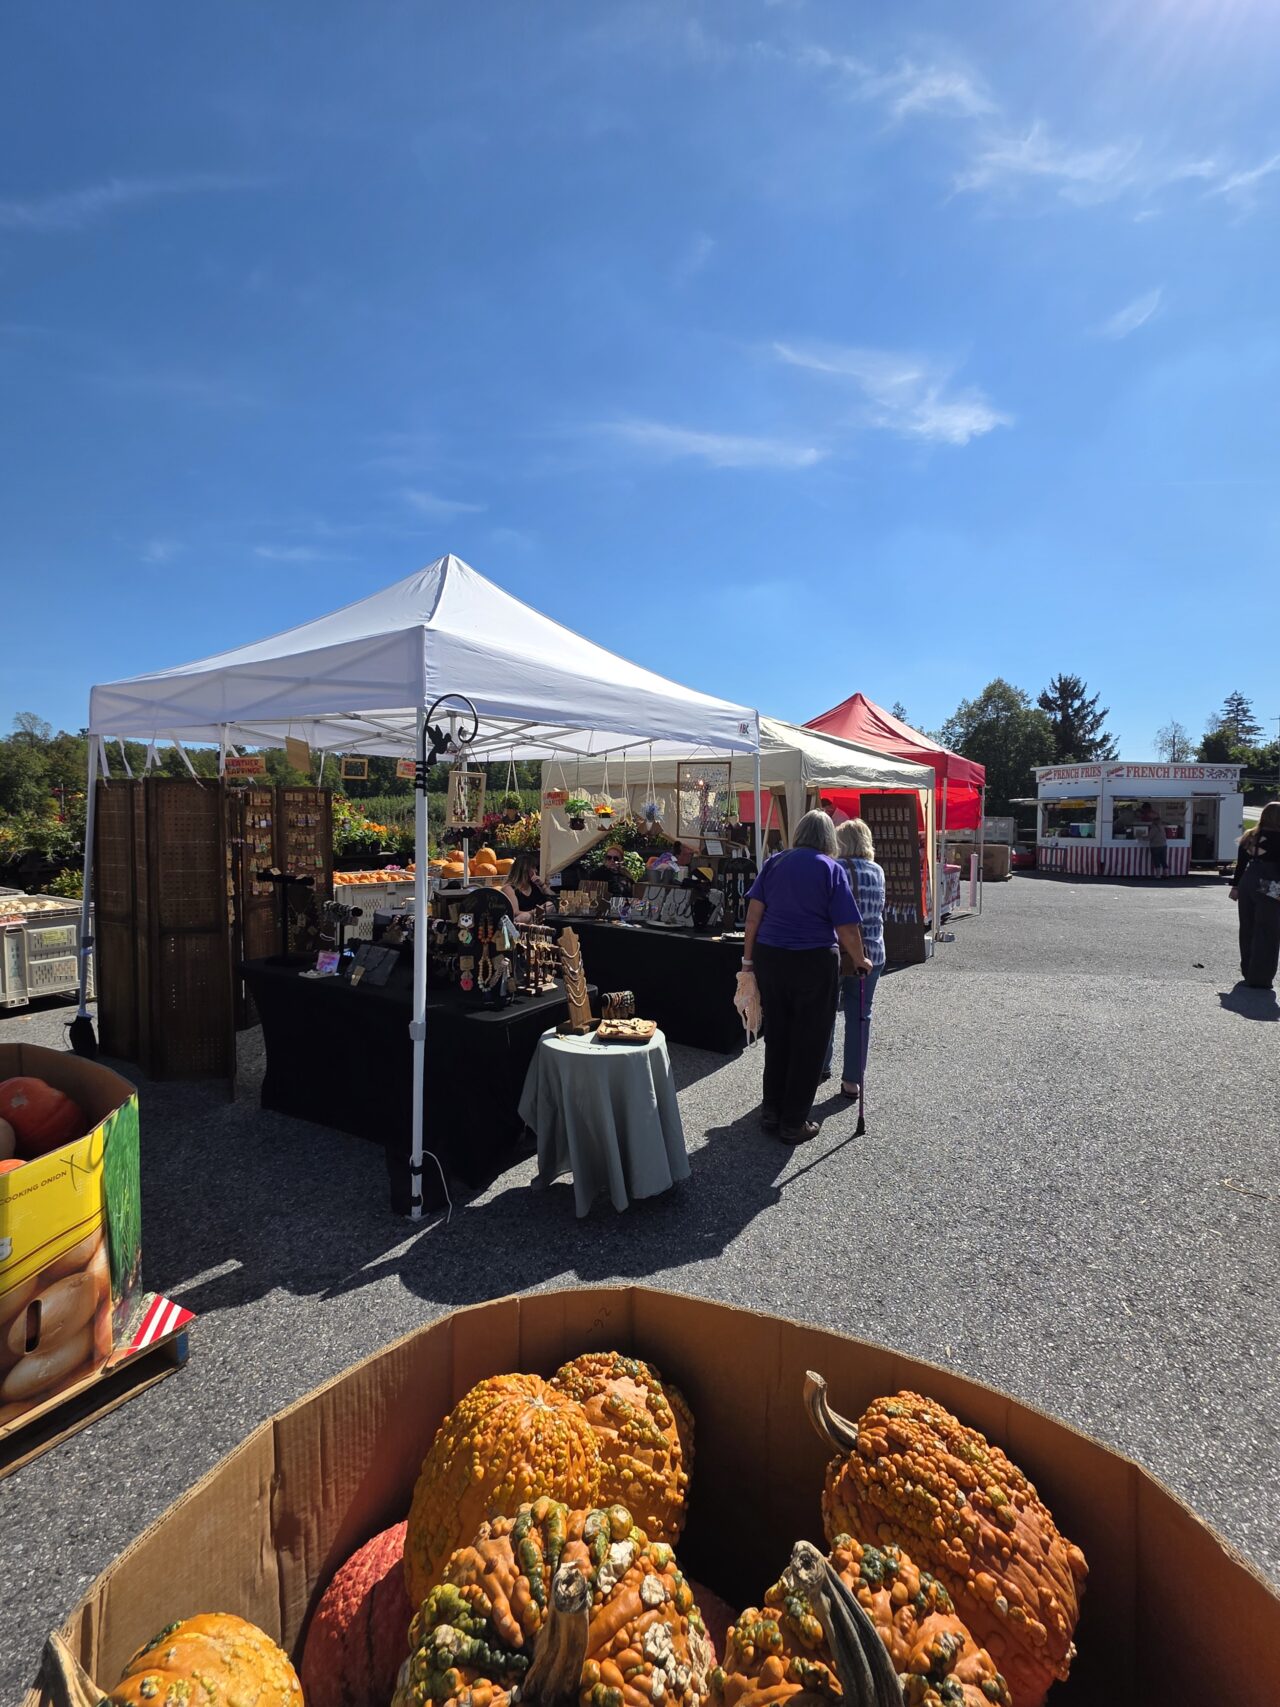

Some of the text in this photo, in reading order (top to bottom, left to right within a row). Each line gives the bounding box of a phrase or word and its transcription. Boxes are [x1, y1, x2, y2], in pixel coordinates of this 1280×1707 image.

[1053, 768, 1080, 780] FRENCH
[1080, 765, 1102, 778] FRIES
[1126, 765, 1171, 778] FRENCH
[1173, 766, 1205, 779] FRIES
[40, 1170, 67, 1187] ONION
